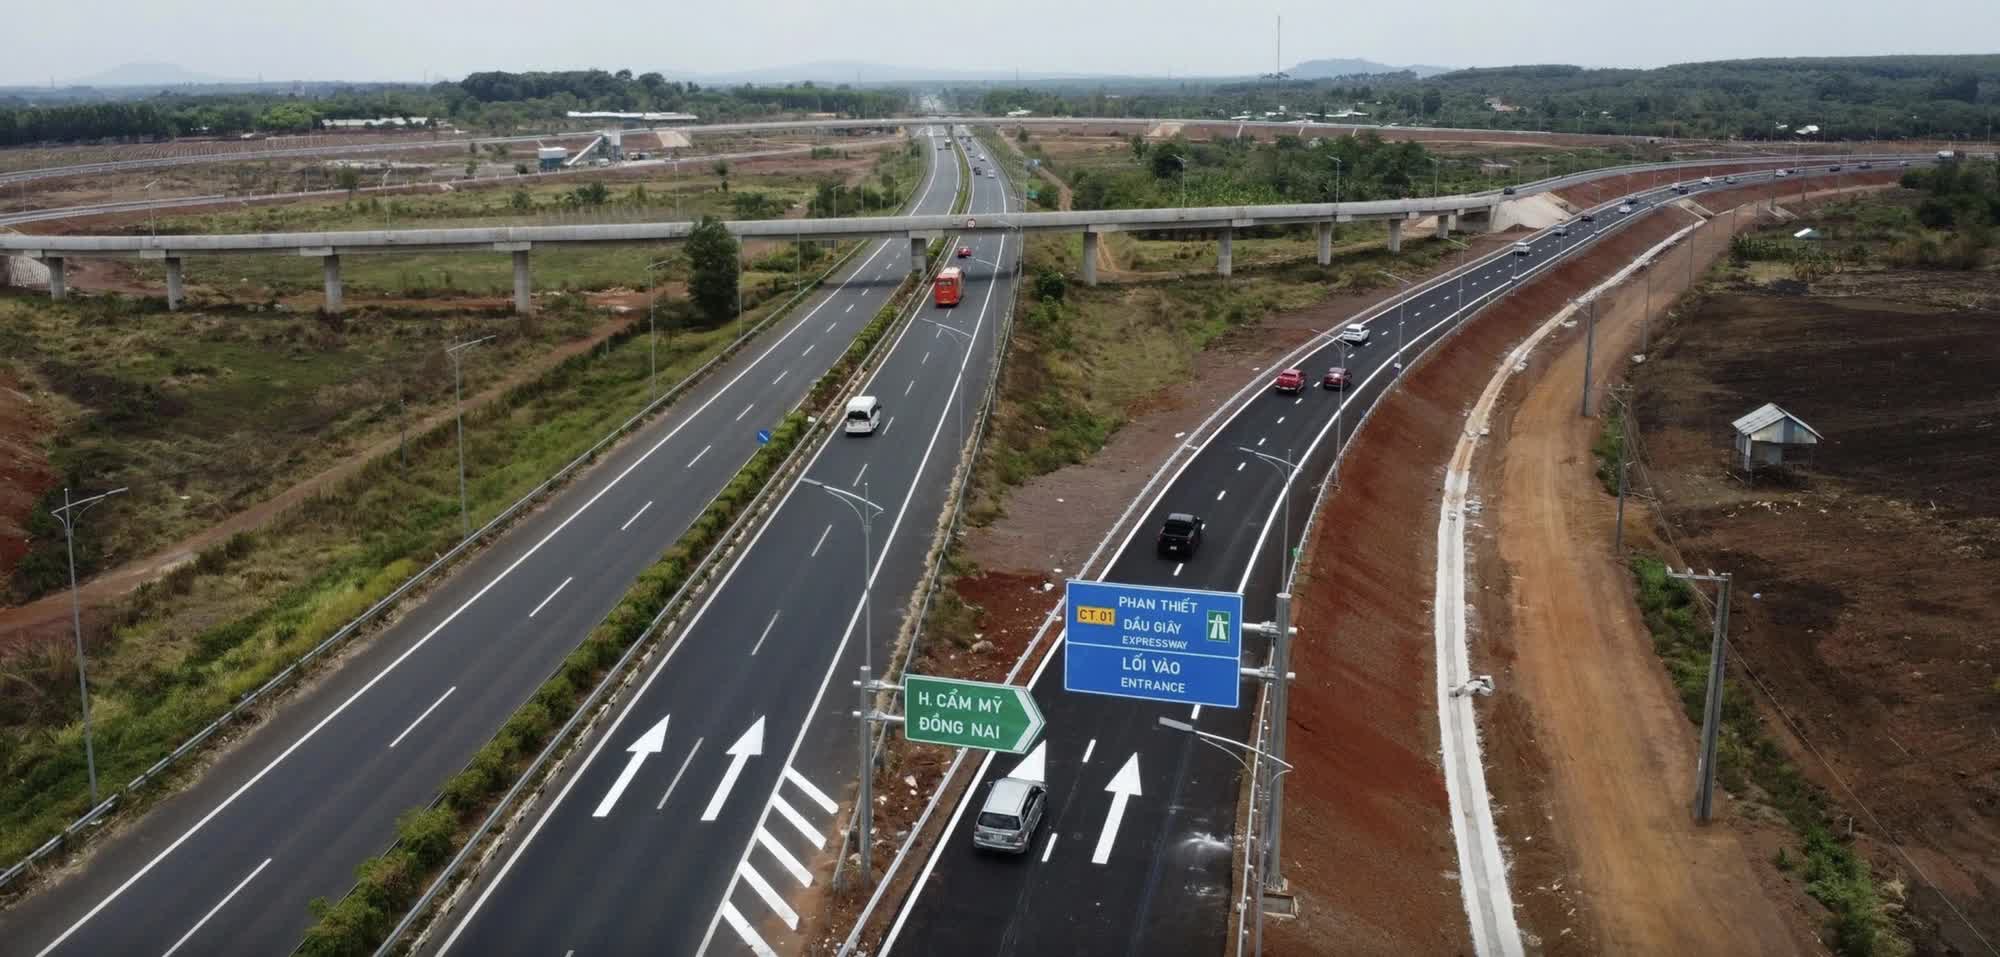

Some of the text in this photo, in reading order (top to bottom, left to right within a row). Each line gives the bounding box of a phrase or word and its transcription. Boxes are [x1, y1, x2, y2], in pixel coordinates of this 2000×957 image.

[1119, 597, 1198, 613] PHAN THIẾT
[1153, 620, 1182, 635] GIÂY
[1122, 635, 1188, 649] EXPRESSWAY
[1122, 653, 1181, 675] LỐI VÀO
[1121, 677, 1185, 693] ENTRANCE
[918, 688, 1003, 714] H. CẨM MỸ
[919, 712, 1000, 739] ĐỒNG NAI
